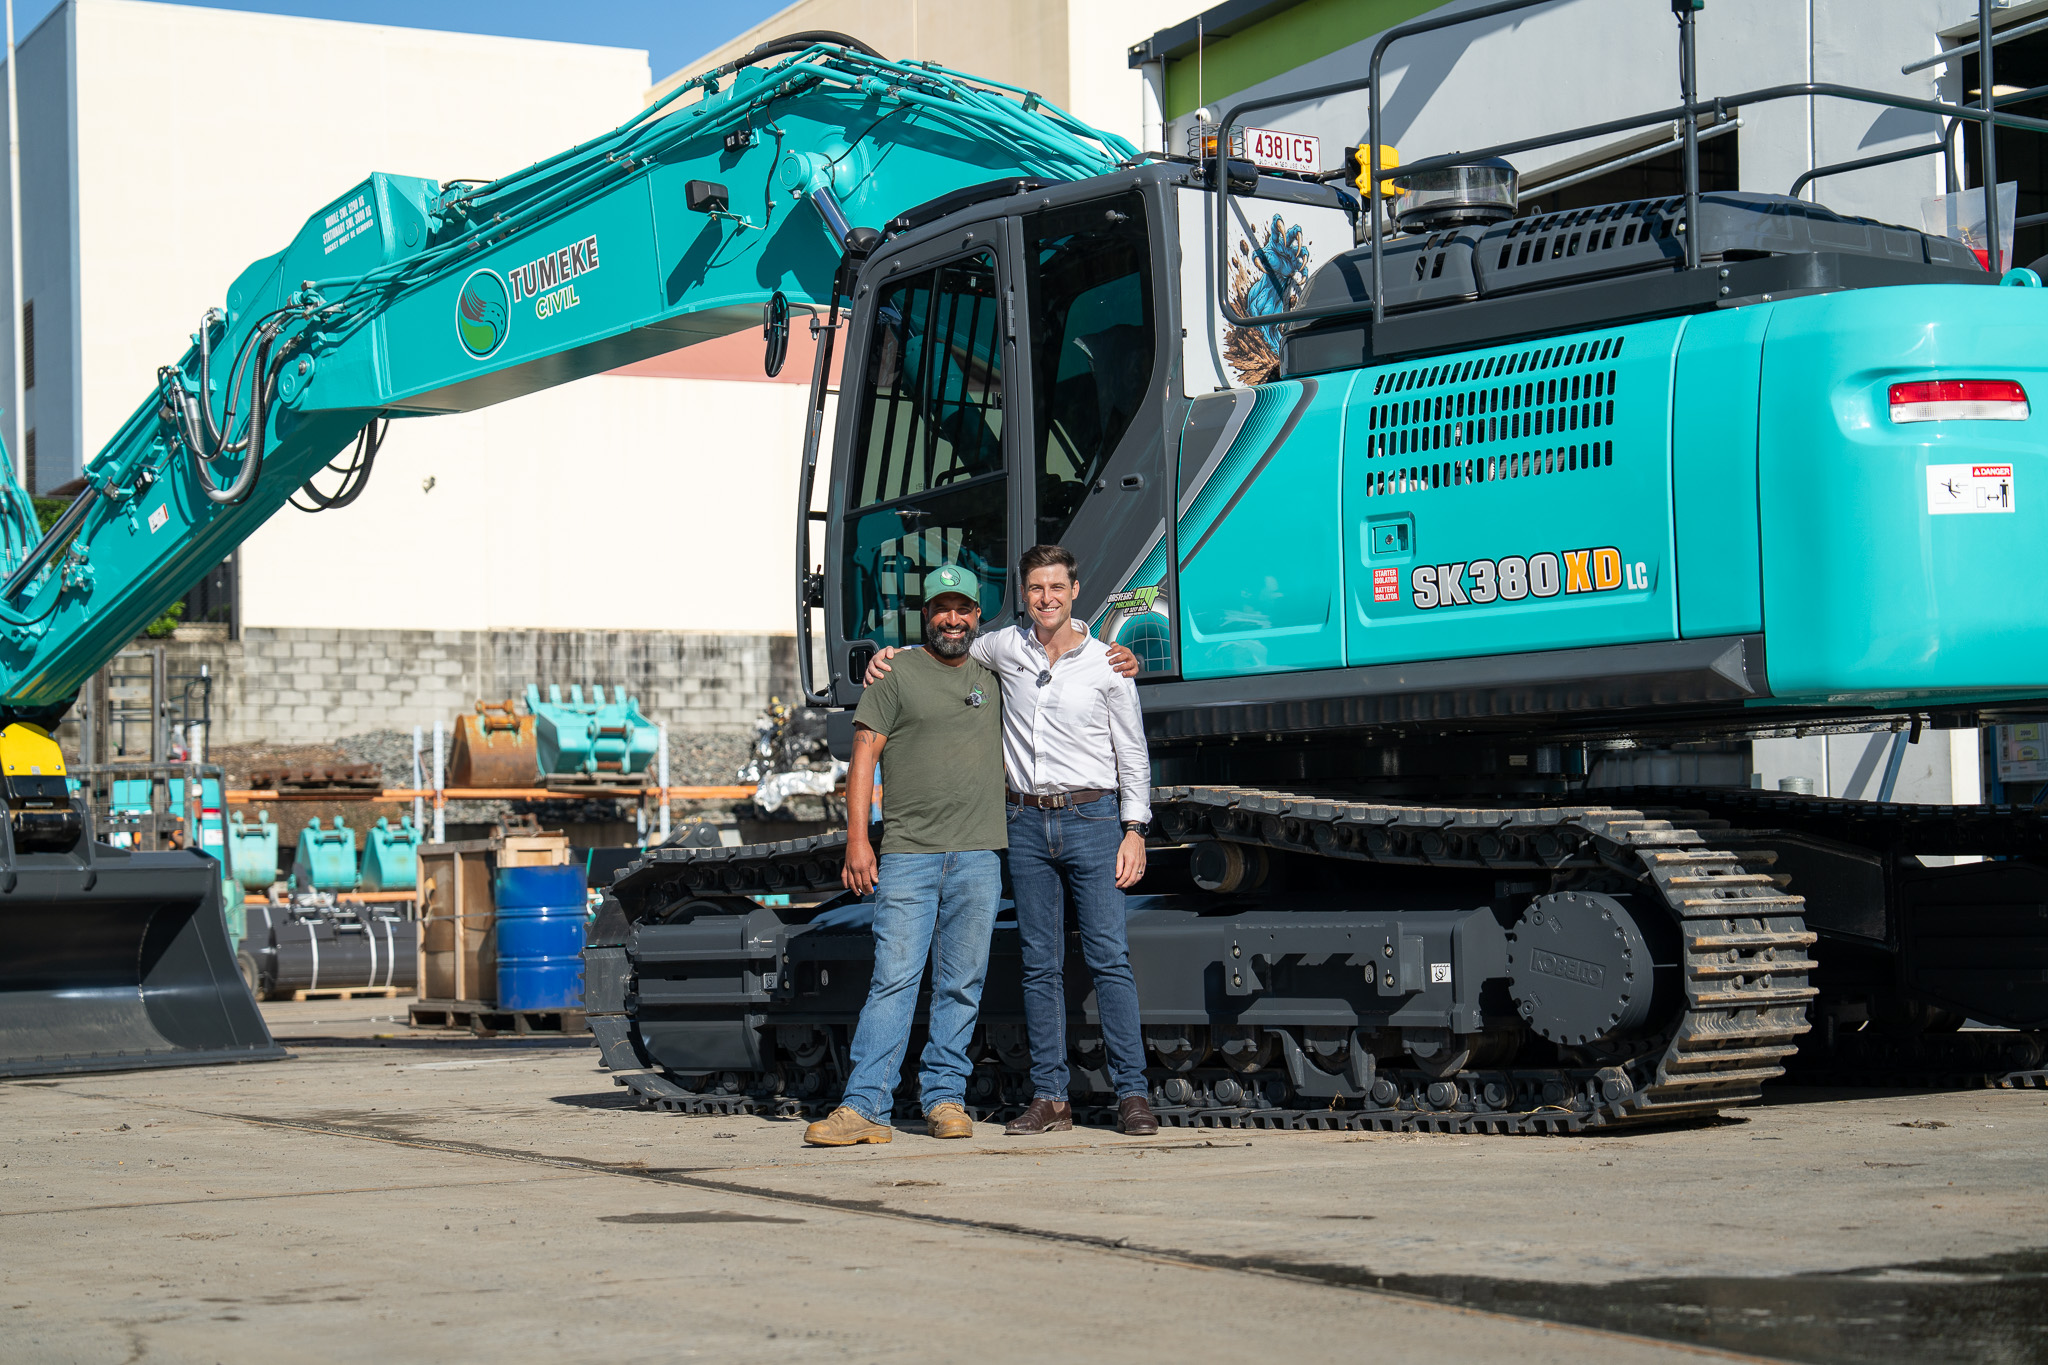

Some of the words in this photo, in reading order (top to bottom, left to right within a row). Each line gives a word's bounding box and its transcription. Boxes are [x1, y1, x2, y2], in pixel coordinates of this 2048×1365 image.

[508, 234, 600, 303] TUMEKE
[535, 284, 580, 320] CIVIL
[1980, 467, 2010, 476] DANGER
[1374, 569, 1397, 578] STARTER
[1625, 561, 1649, 590] LC
[1374, 576, 1398, 584] ISOLATOR
[1375, 585, 1397, 594] BATTERY
[1375, 593, 1398, 601] ISOLATOR
